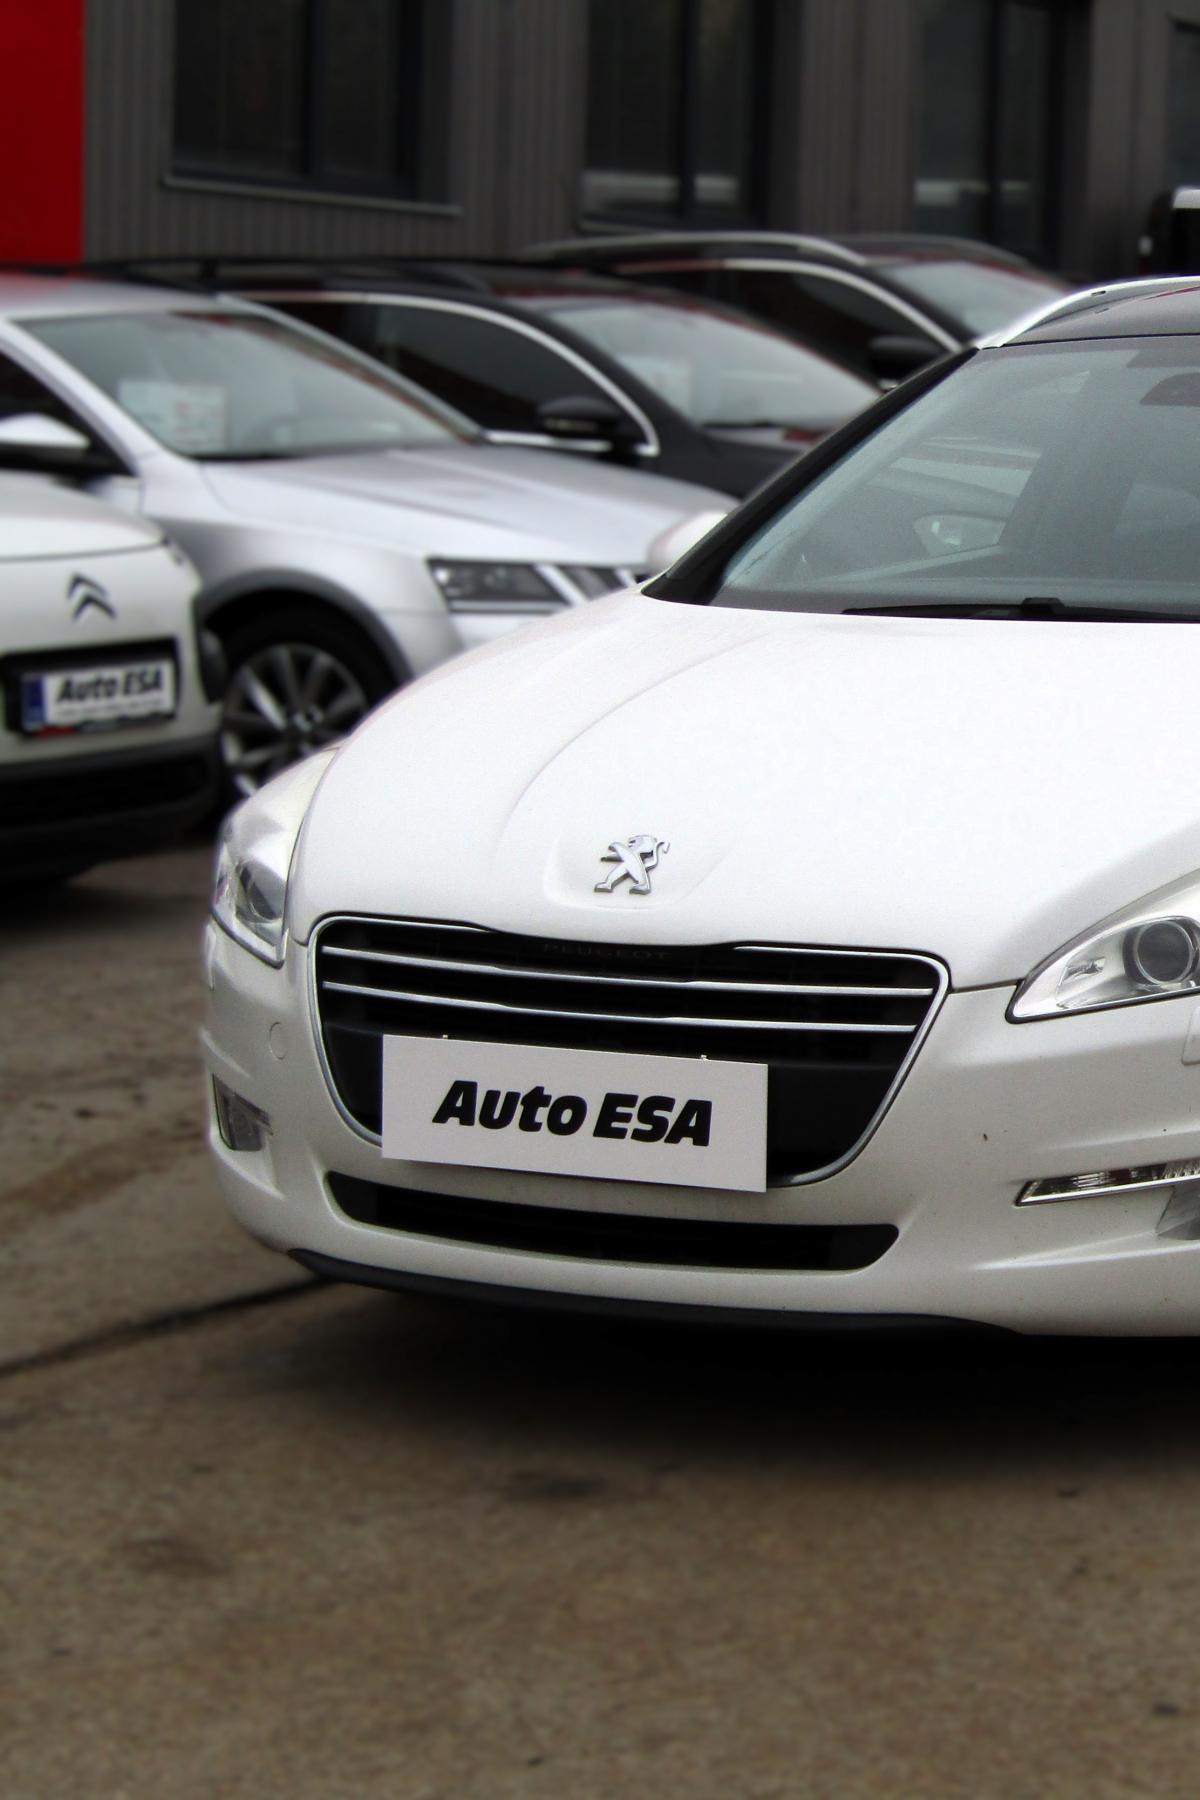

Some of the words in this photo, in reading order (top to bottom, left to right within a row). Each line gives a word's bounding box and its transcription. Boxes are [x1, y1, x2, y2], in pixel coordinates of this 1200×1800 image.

[57, 675, 118, 704] Auto
[122, 665, 163, 696] ESA
[432, 1079, 588, 1136] Auto
[592, 1092, 713, 1147] ESA
